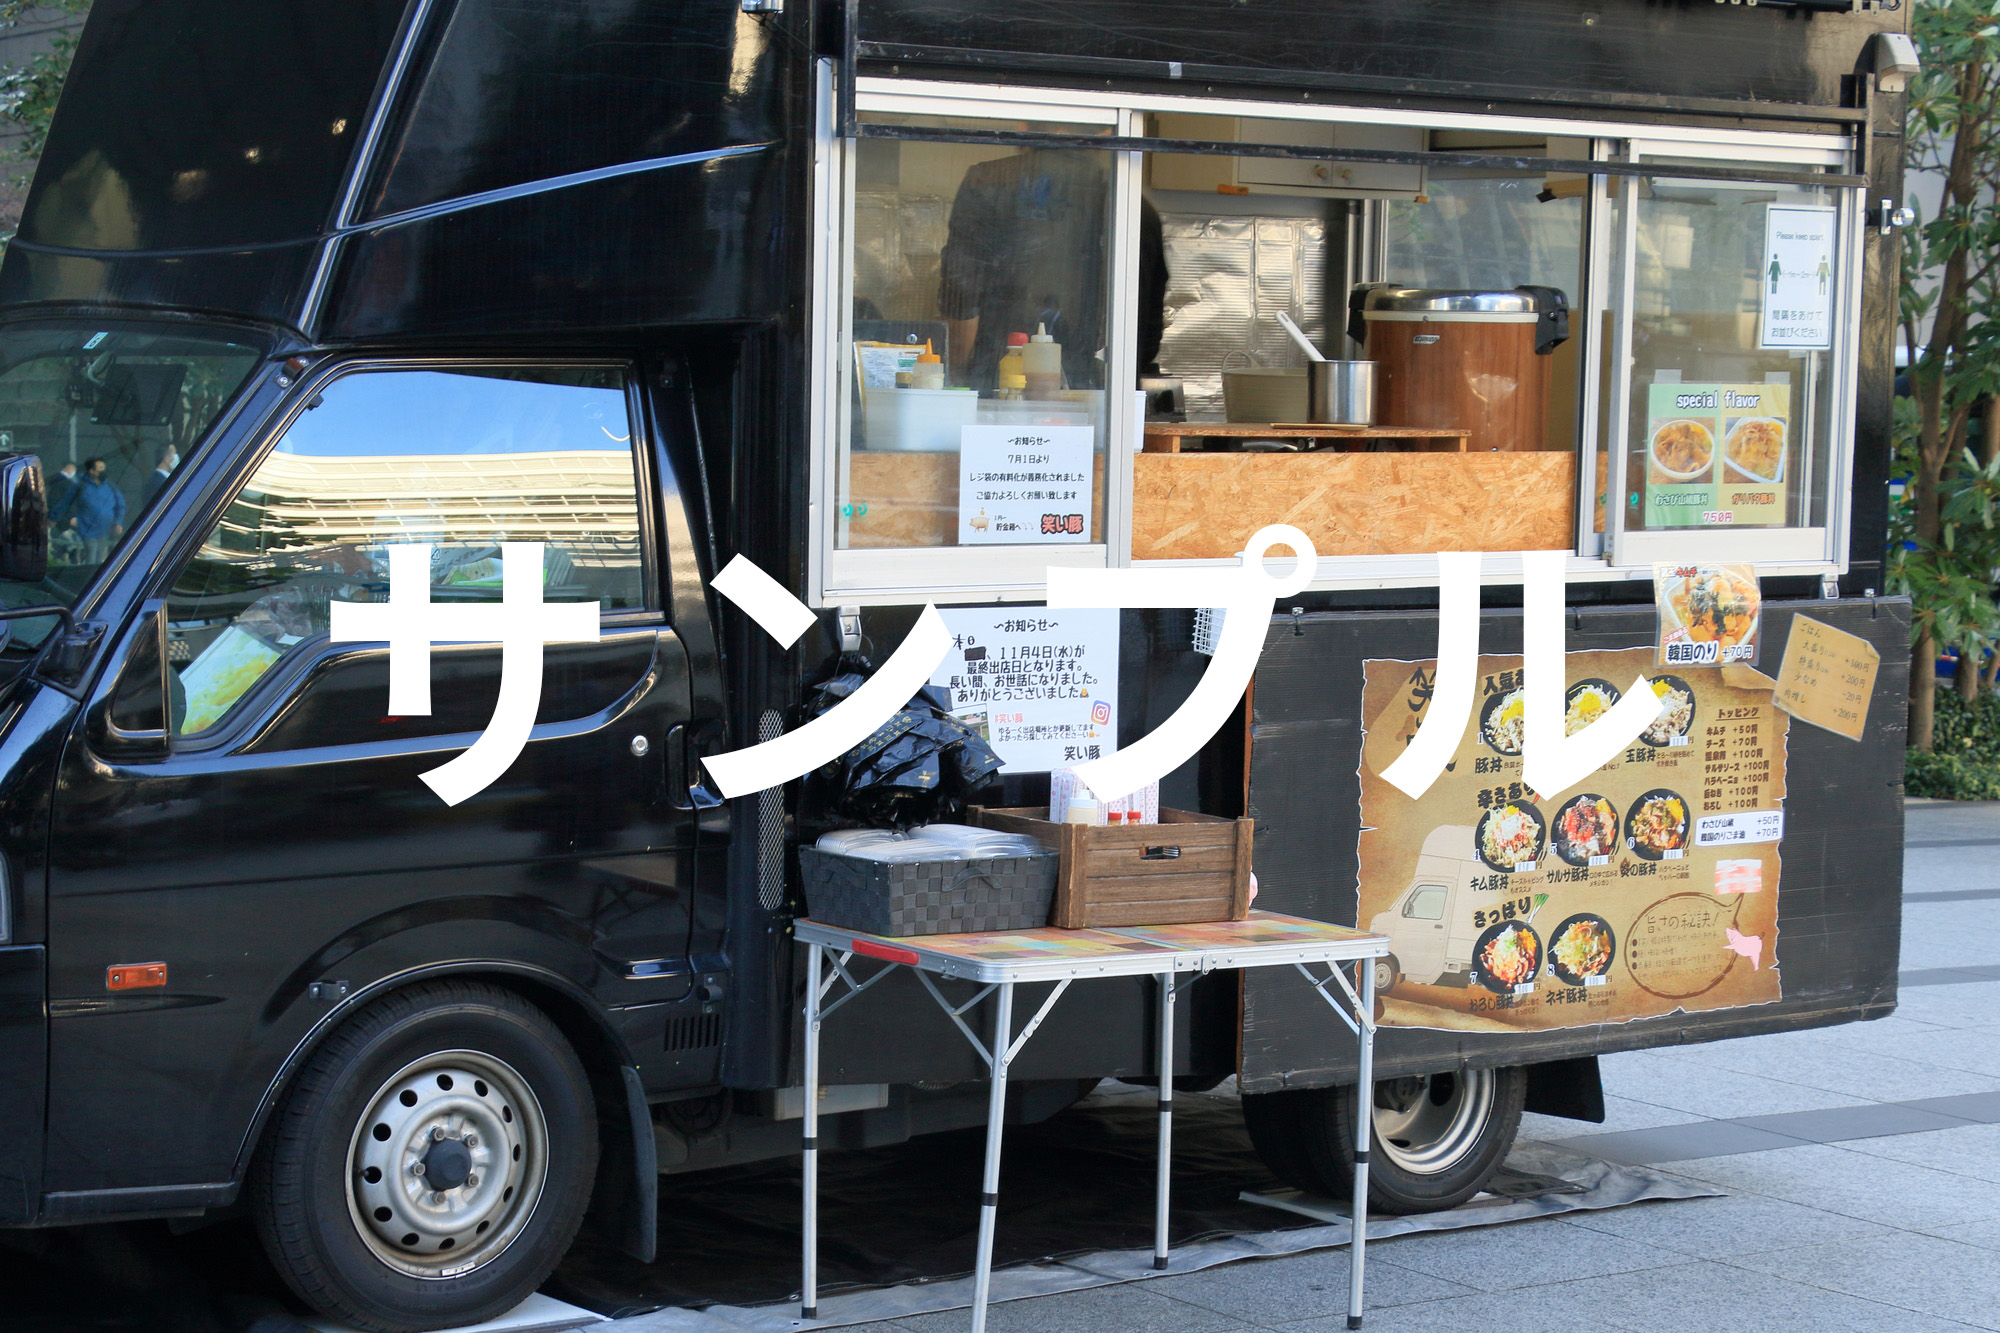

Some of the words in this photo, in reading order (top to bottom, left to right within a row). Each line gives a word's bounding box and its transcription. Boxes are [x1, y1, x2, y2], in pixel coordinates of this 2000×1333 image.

[1776, 231, 1794, 240] Please
[1795, 231, 1808, 241] keep
[1772, 309, 1824, 321] 間隔をあけて
[1771, 327, 1823, 338] お並びください
[1676, 390, 1718, 410] special
[1723, 390, 1760, 408] flavor
[969, 472, 1085, 482] レジ袋の有料化が義務化されました
[976, 490, 1078, 501] ご協力よろしくお願い致します
[1040, 513, 1084, 535] 笑い豚
[1702, 511, 1733, 523] 750円
[1800, 622, 1821, 638] ごはん
[1667, 642, 1718, 662] 韓国のり
[966, 659, 1083, 675] 最終出店日となります。
[950, 672, 1098, 689] 長い間、お世話になりました。
[957, 686, 1080, 703] ありがとうございました
[1718, 706, 1760, 719] トッピング
[1706, 726, 1727, 736] キムチ
[1706, 738, 1726, 749] チーズ
[1064, 744, 1101, 761] 笑い豚
[1625, 746, 1656, 763] 玉豚丼
[1474, 757, 1503, 774] 豚丼
[1704, 762, 1740, 774] サルサソース
[1703, 800, 1722, 811] おろし
[1627, 836, 1636, 850] 6
[1700, 830, 1746, 843] 韓国のりごま油
[1550, 843, 1557, 855] 5
[1546, 866, 1589, 884] サルサ豚丼
[1620, 861, 1657, 878] 炎の豚丼
[1469, 873, 1509, 892] キム豚丼
[1473, 896, 1531, 929] さっぱり
[1547, 963, 1555, 977] 8
[1469, 971, 1478, 985] 7
[1469, 995, 1514, 1012] おろし豚丼
[1545, 986, 1588, 1006] ネギ豚丼
